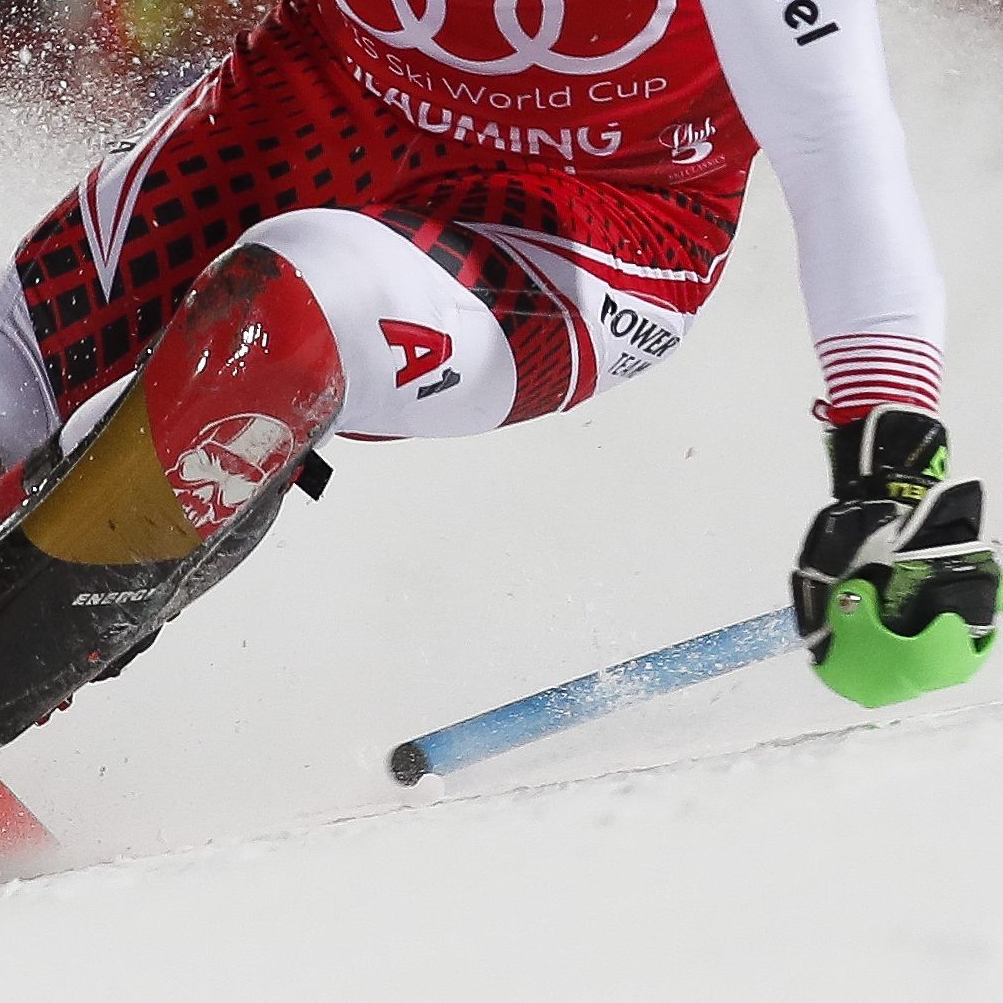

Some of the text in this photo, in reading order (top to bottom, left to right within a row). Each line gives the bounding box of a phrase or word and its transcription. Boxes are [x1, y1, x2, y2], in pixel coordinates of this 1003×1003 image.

[386, 54, 432, 91] Ski
[442, 77, 572, 110] World
[588, 76, 668, 104] Cup
[600, 291, 680, 357] POWER
[378, 319, 461, 400] A1
